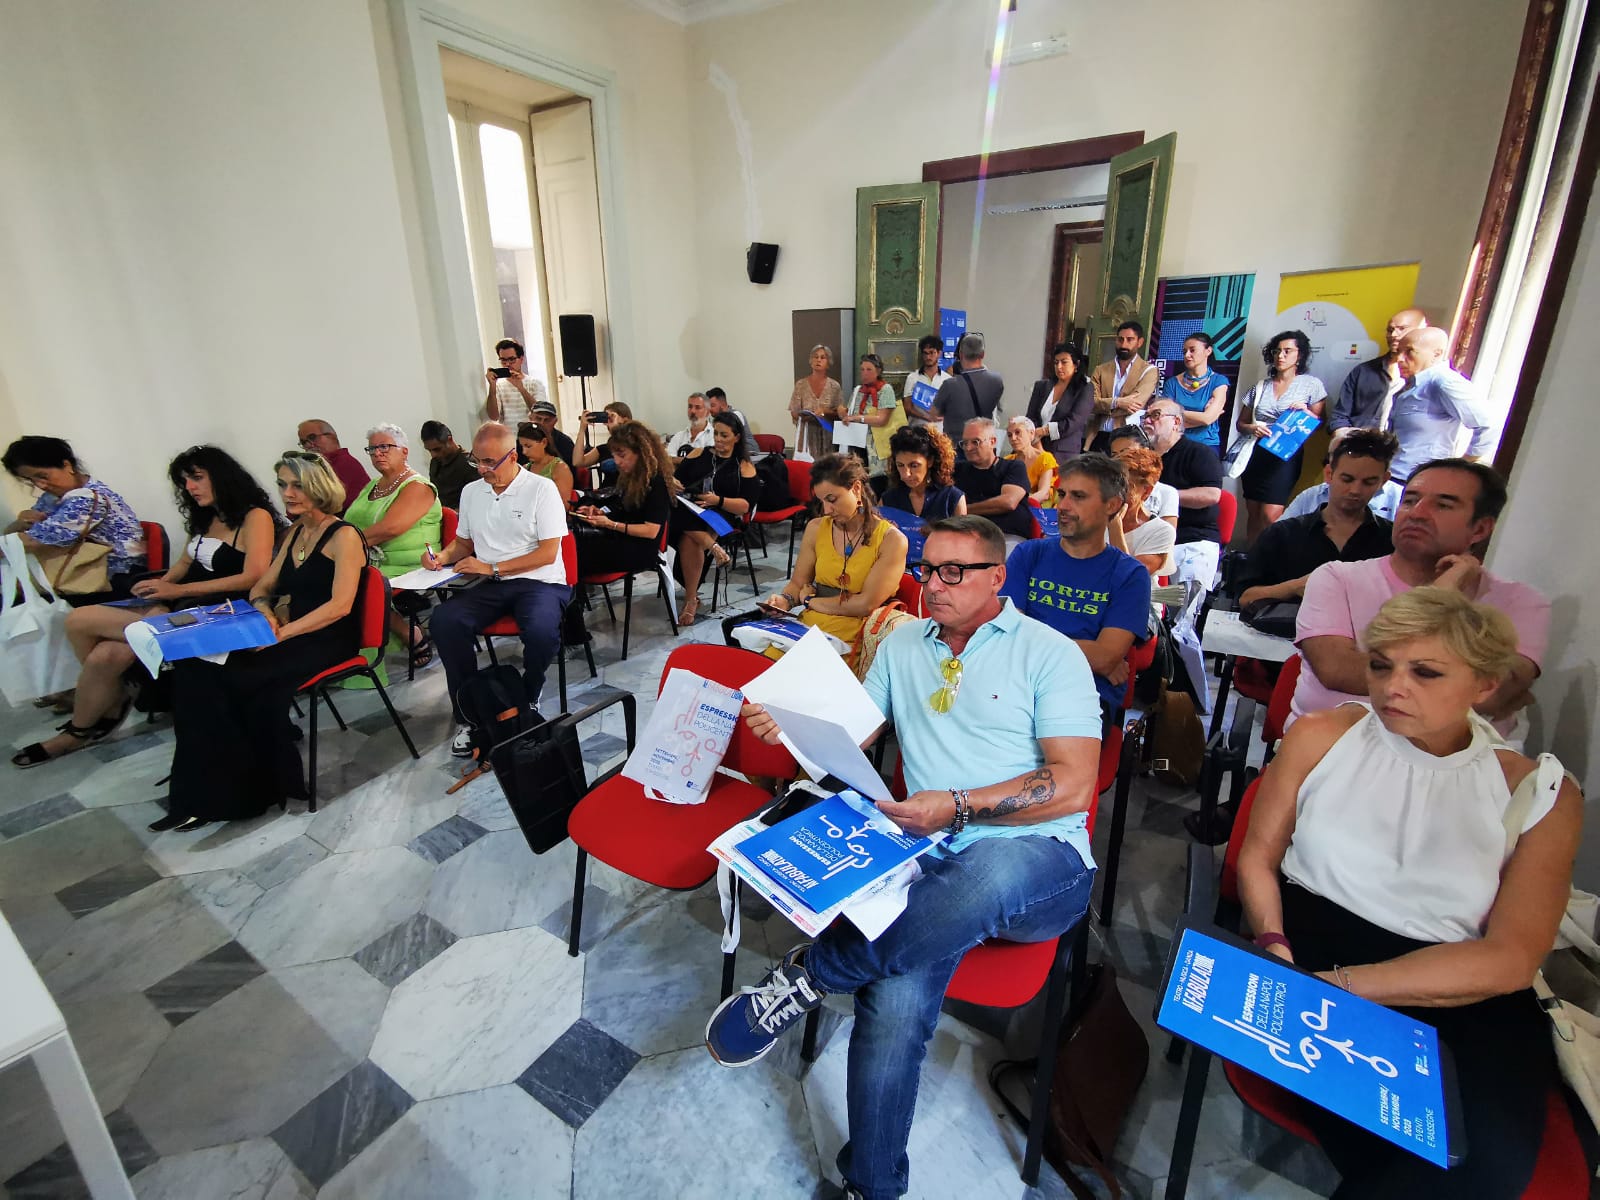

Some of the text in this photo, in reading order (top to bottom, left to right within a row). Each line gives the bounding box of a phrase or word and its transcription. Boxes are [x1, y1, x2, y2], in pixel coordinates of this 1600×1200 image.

[1028, 591, 1099, 615] SAILS
[1173, 949, 1194, 1002] TEATRO MUSICA DANZA
[1241, 972, 1260, 1024] ESPRESSIONI
[1255, 976, 1273, 1030] DELLA NAPOLI
[1270, 981, 1288, 1037] POLICENTRICA
[1390, 1092, 1401, 1132] NOVEMBRE
[1403, 1118, 1412, 1137] 2023
[1415, 1116, 1424, 1143] EVENTI
